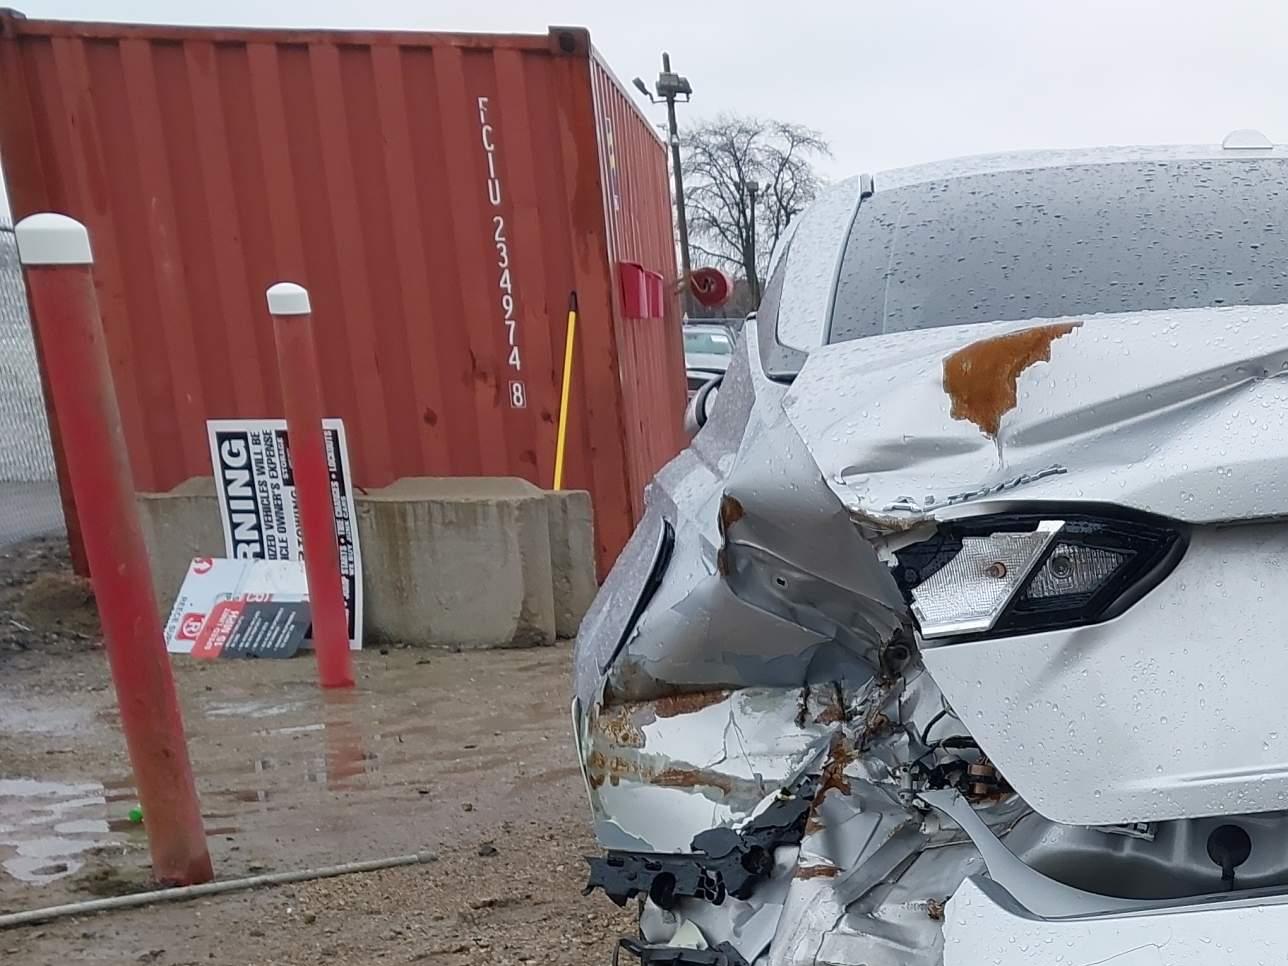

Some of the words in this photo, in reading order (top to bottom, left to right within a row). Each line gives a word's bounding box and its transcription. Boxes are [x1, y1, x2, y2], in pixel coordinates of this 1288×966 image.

[478, 97, 500, 205] FCIU
[493, 216, 520, 371] 234974
[512, 382, 523, 407] 8
[251, 431, 261, 446] BE
[253, 449, 266, 476] WILL
[263, 429, 278, 479] EXPENSE
[277, 437, 289, 479] STORAGE
[258, 480, 274, 530] VEHICLES
[271, 483, 287, 533] OWNER'S
